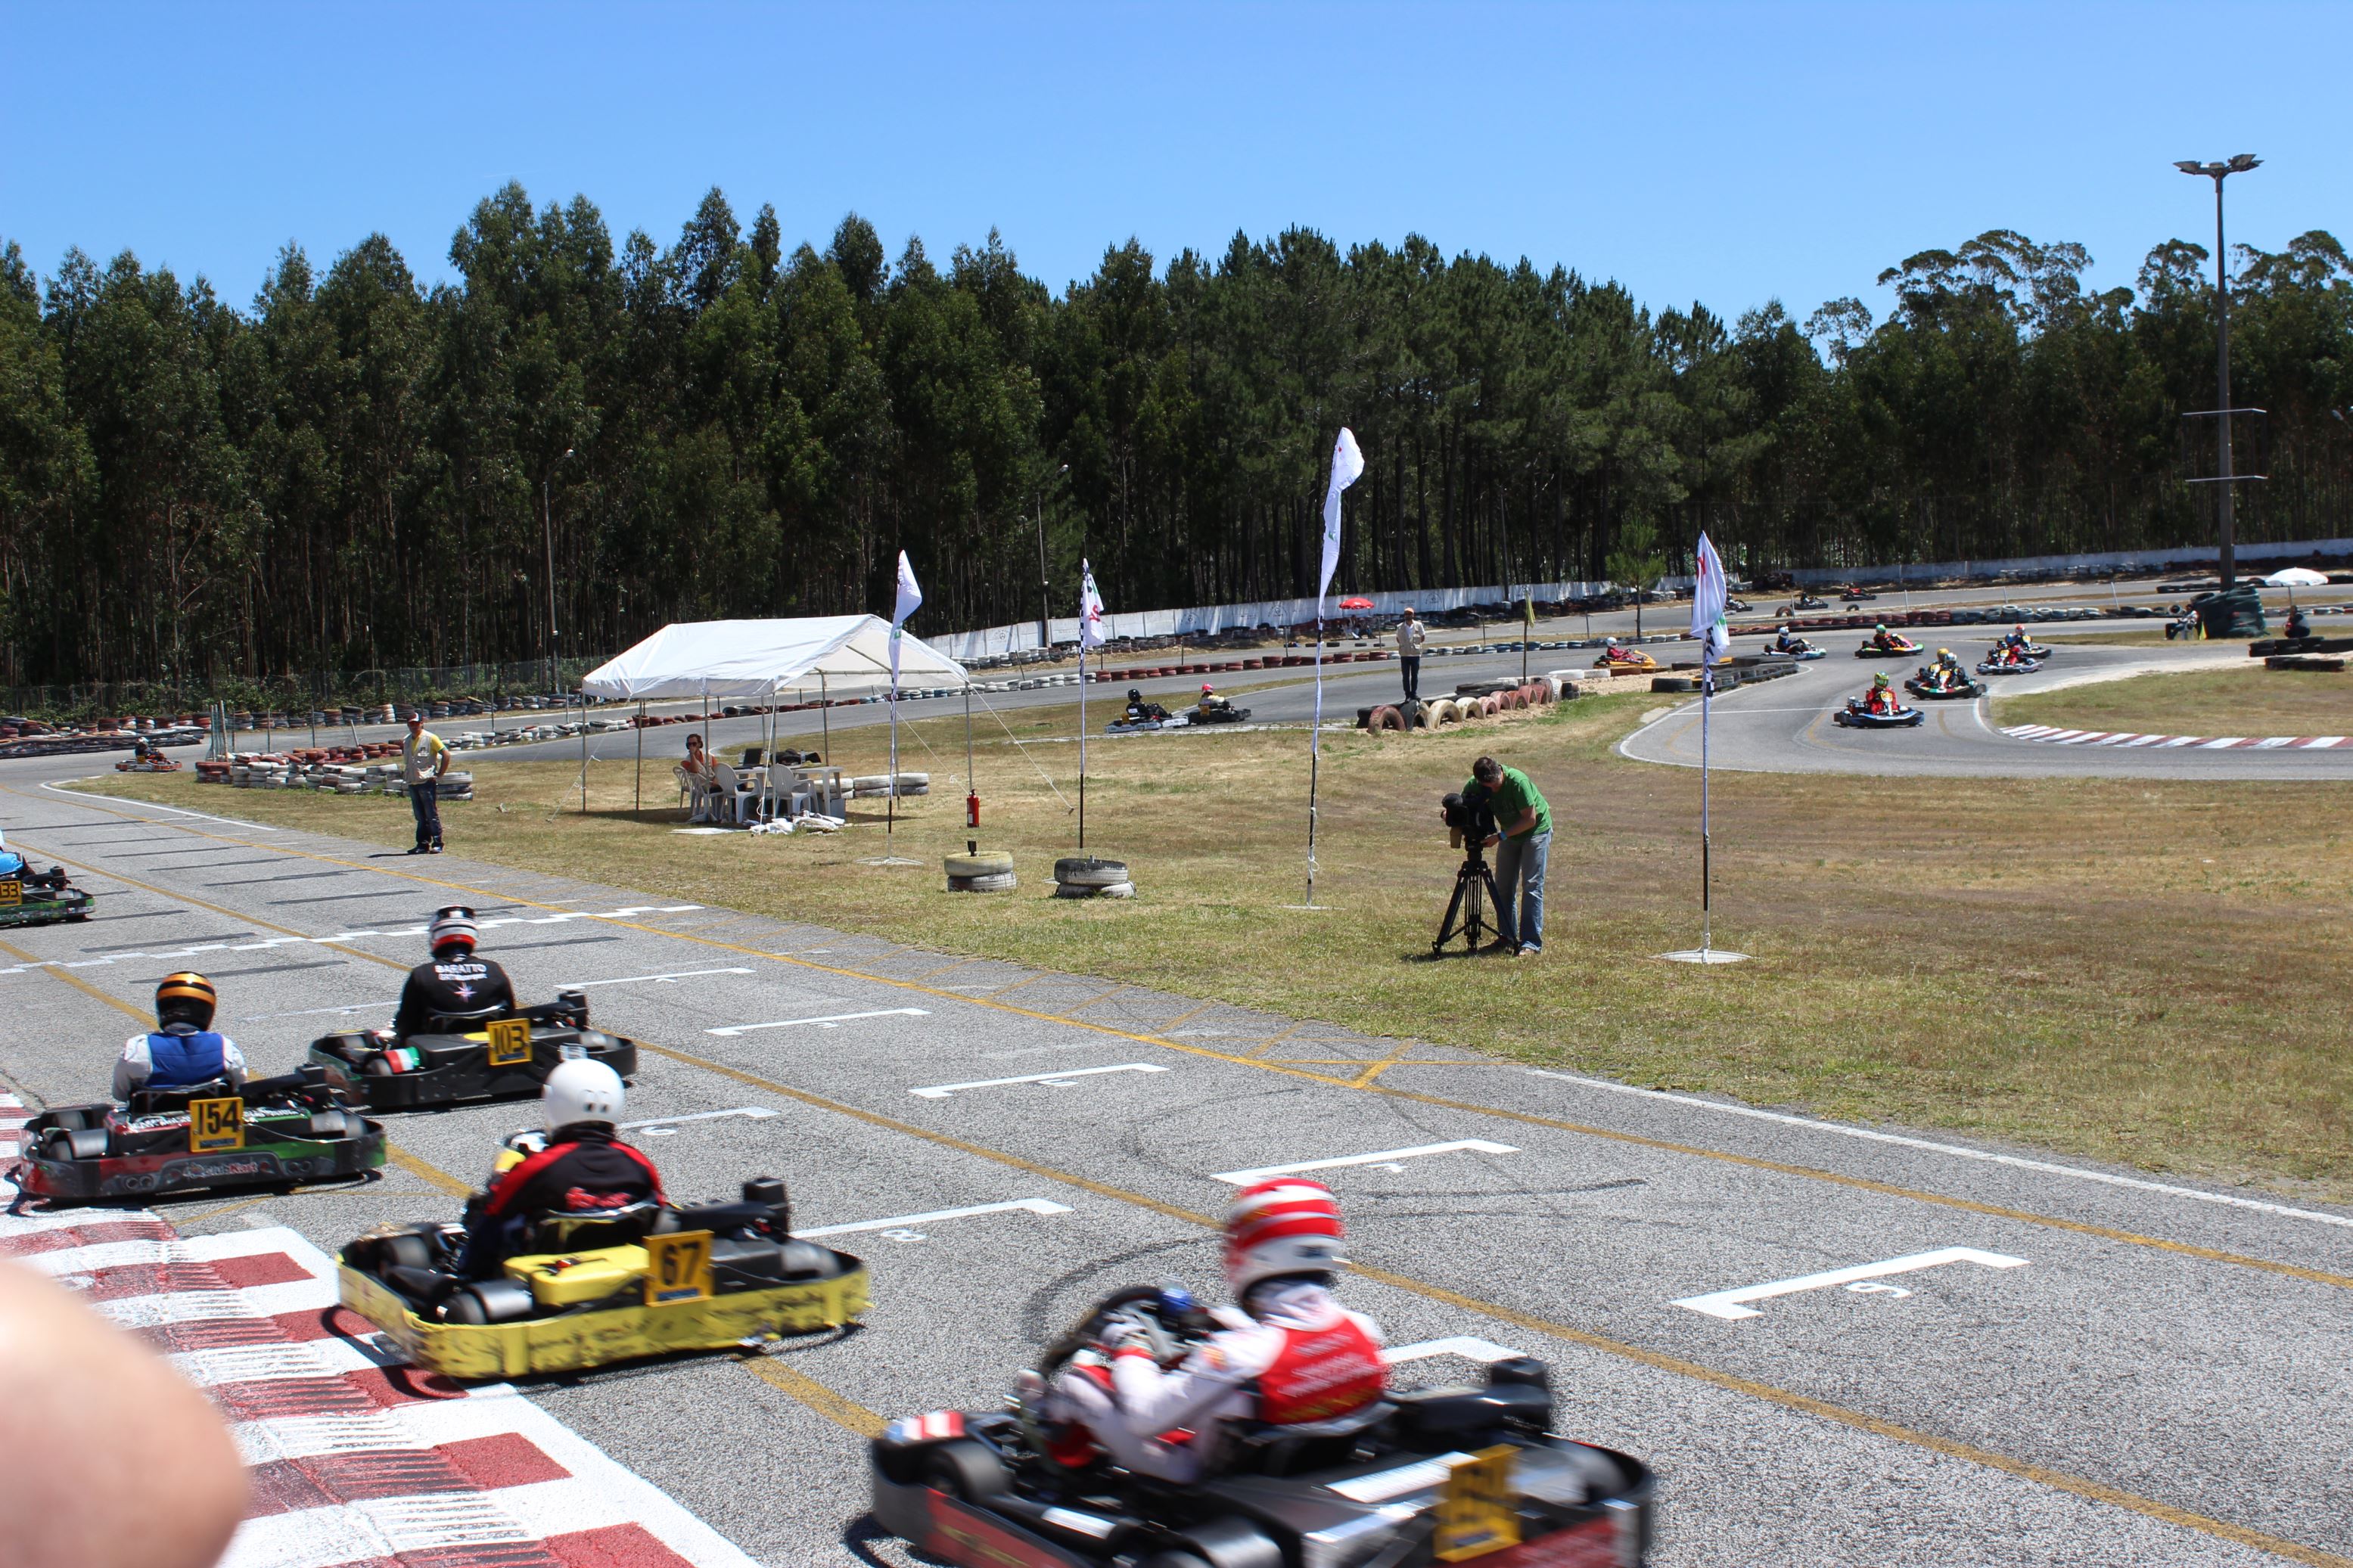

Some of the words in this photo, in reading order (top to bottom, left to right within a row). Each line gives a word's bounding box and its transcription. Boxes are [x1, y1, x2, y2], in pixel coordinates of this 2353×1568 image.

[494, 1026, 524, 1054] 103
[197, 1101, 241, 1135] 154
[881, 1229, 926, 1241] 8
[660, 1241, 702, 1286] 67
